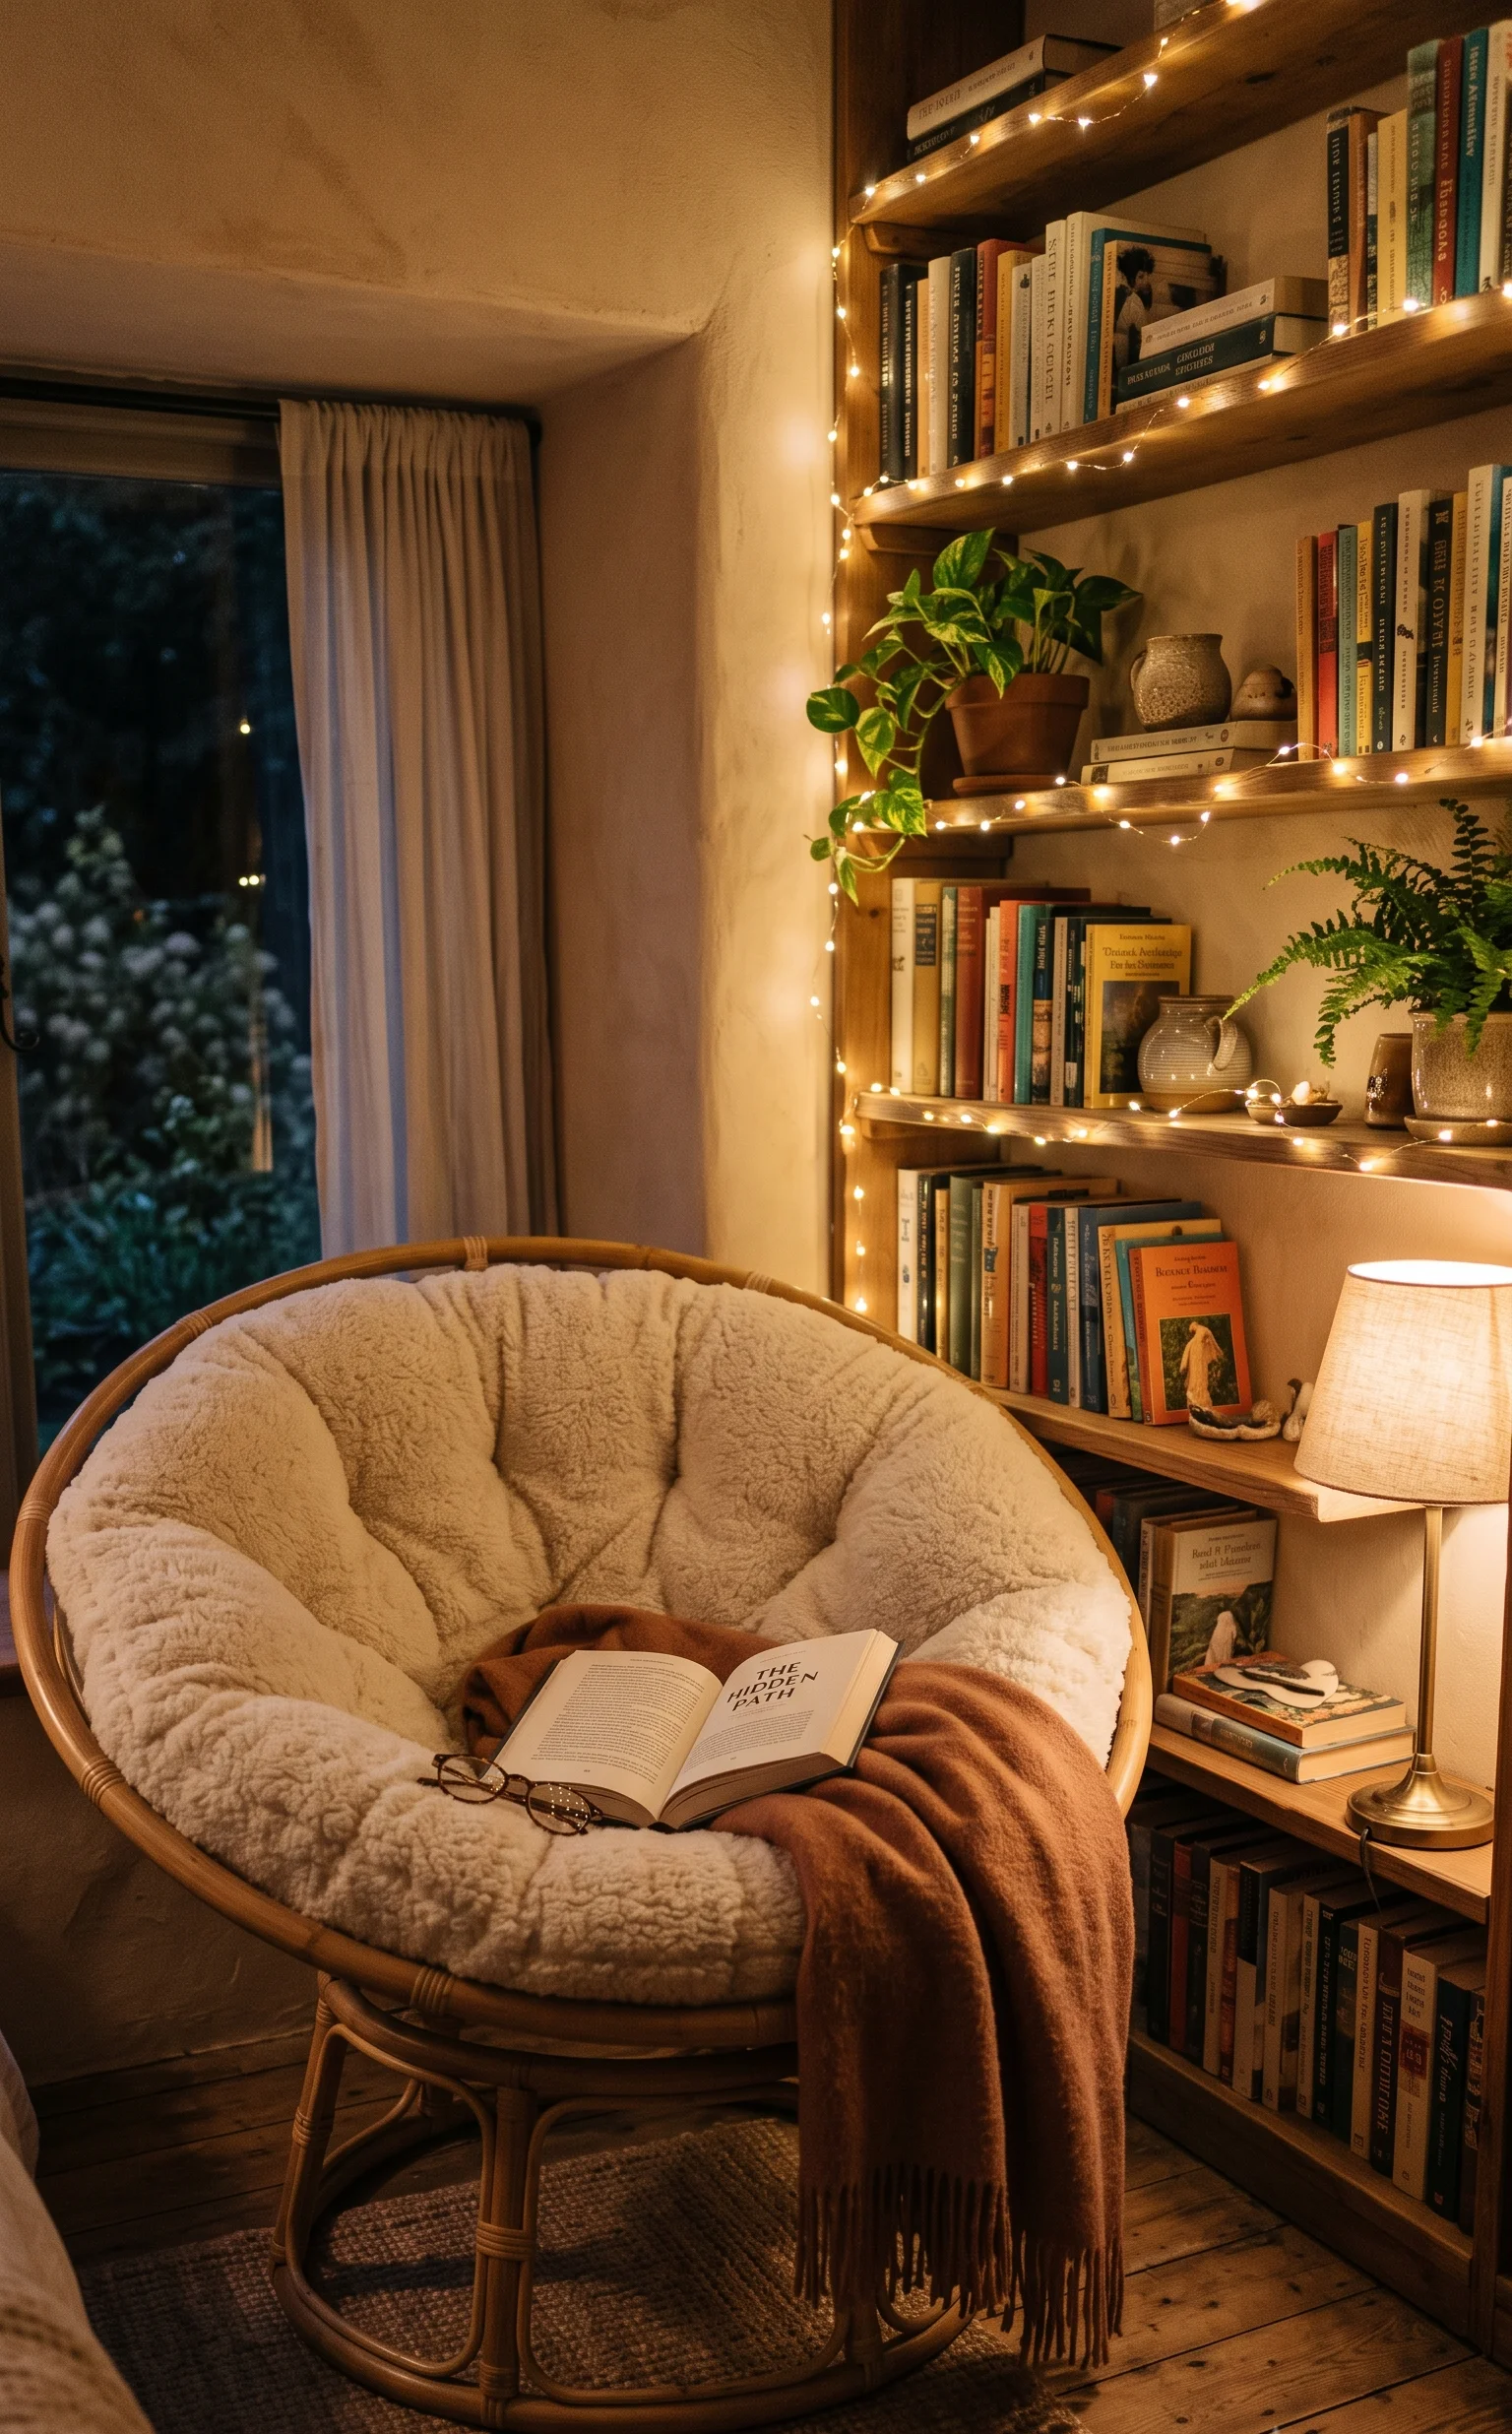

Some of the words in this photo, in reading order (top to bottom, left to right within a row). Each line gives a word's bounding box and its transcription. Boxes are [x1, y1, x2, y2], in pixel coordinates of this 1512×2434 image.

[757, 1661, 801, 1681] THE
[726, 1671, 819, 1703] HIDDEN
[731, 1688, 795, 1712] PATH
